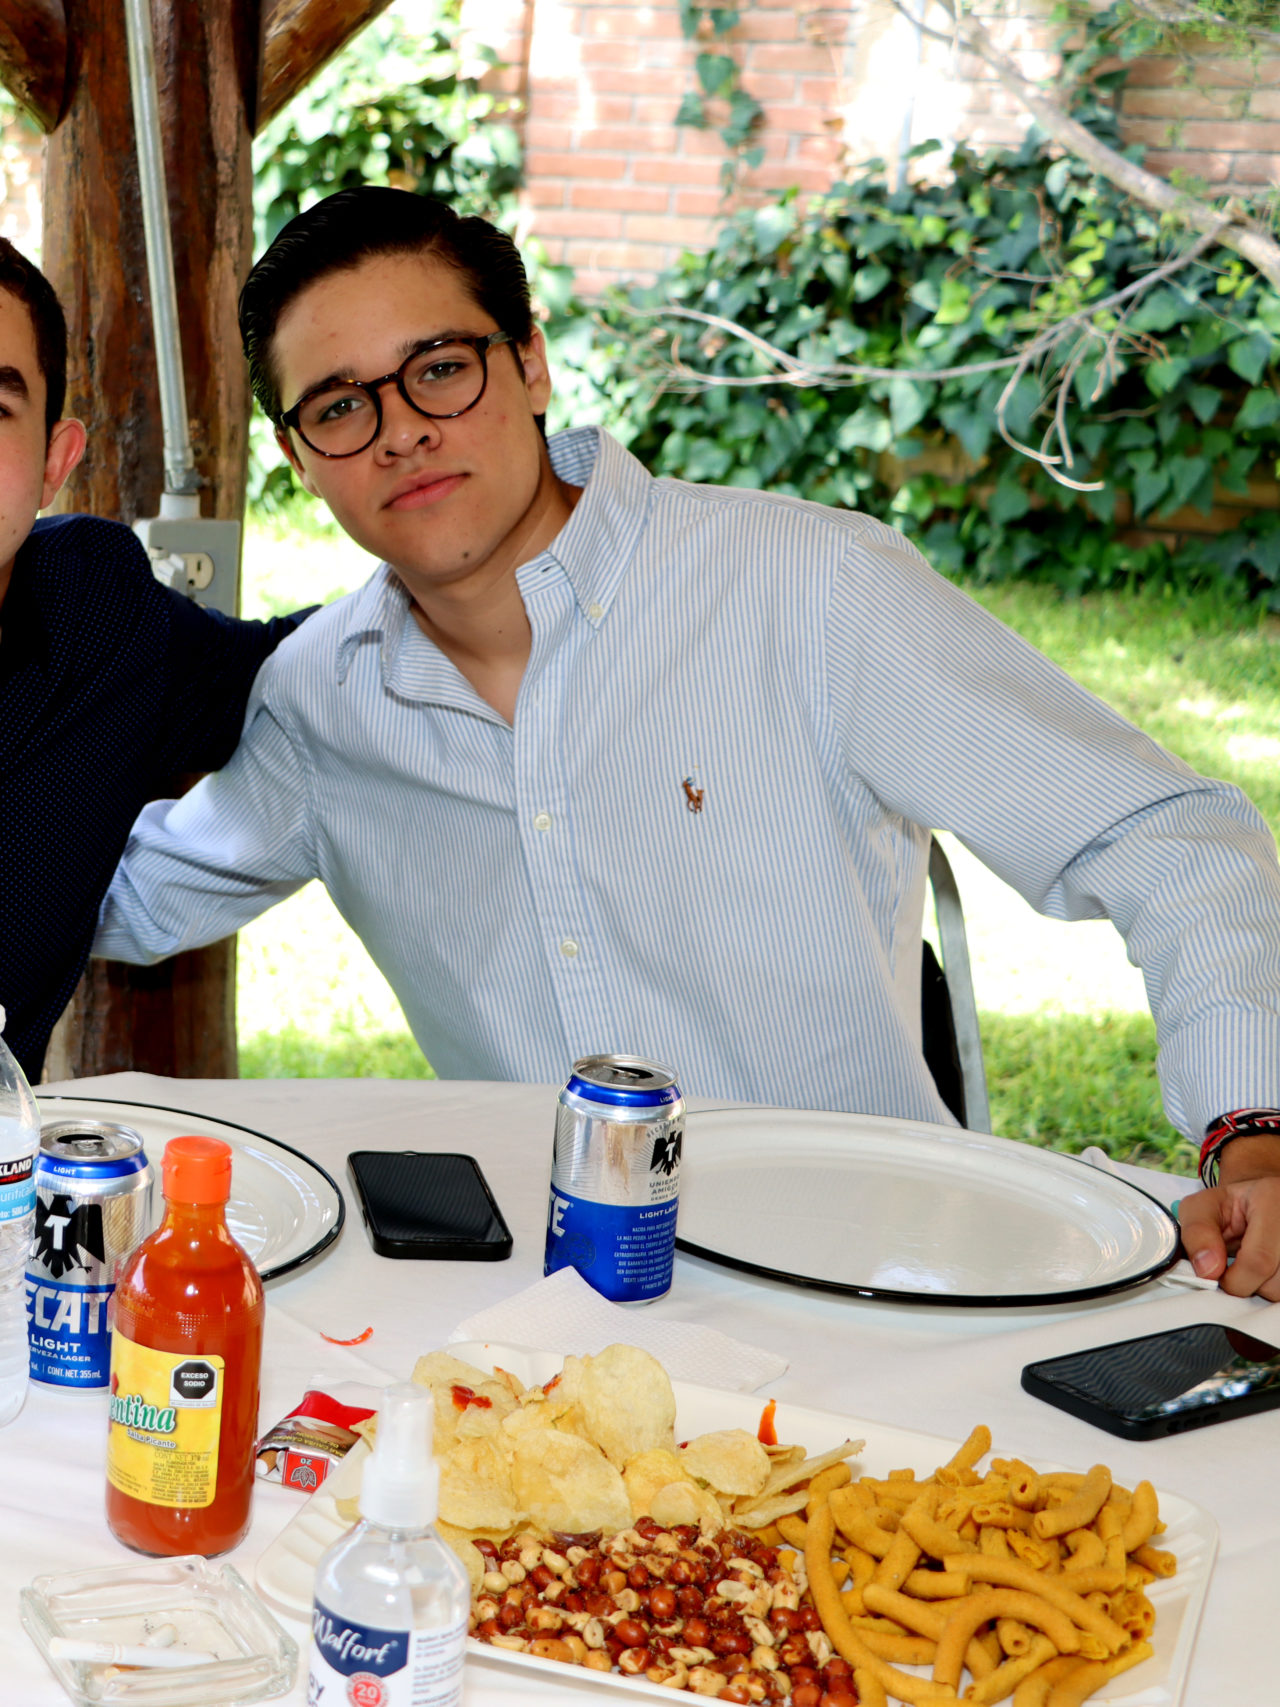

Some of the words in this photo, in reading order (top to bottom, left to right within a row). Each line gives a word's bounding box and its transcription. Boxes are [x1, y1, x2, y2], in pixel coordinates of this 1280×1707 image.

[53, 1166, 76, 1175] LIGHT
[639, 1210, 664, 1219] LIGHT
[665, 1203, 678, 1215] LAGE
[24, 1284, 113, 1334] ECAT
[31, 1333, 81, 1353] LIGHT
[29, 1345, 58, 1359] ERVEZA
[60, 1354, 91, 1362] LAGER
[47, 1365, 63, 1377] CONT.
[65, 1369, 78, 1377] NET.
[109, 1394, 177, 1433] entina
[127, 1429, 146, 1443] Salsa
[146, 1435, 176, 1448] Picante
[300, 1457, 313, 1466] 20
[313, 1608, 393, 1664] Walfort
[356, 1683, 378, 1698] 20
